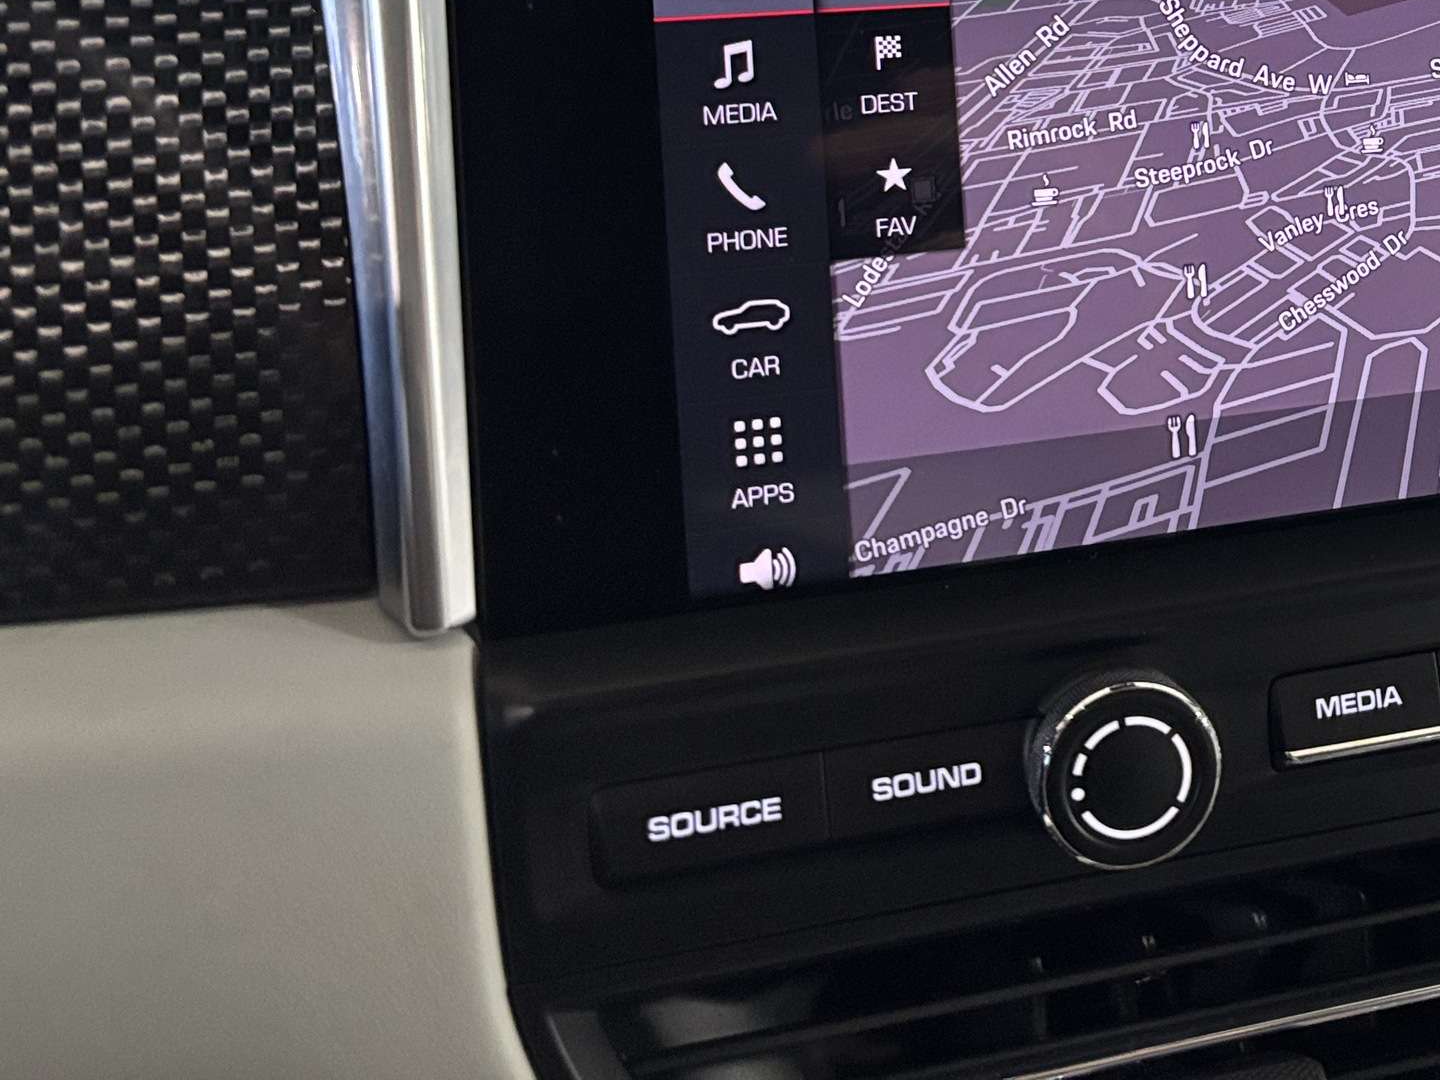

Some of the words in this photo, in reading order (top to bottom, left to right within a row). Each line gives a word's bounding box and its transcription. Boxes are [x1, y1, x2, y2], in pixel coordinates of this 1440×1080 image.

[984, 46, 1037, 98] Allen
[1036, 15, 1071, 52] Rd
[1253, 64, 1296, 92] Ave
[1308, 74, 1332, 95] W
[702, 101, 778, 126] MEDIA
[860, 92, 918, 115] DEST
[1007, 117, 1098, 151] Rimrock
[1108, 109, 1139, 133] Rd
[1134, 149, 1242, 189] Steeprock
[1249, 138, 1275, 159] Dr
[707, 228, 788, 253] PHONE
[875, 215, 917, 238] FAV
[1259, 210, 1325, 253] Vanley
[1334, 200, 1379, 223] Cres
[1278, 251, 1382, 333] Chesswood
[1383, 228, 1410, 255] Dr
[731, 355, 781, 381] CAR
[730, 481, 796, 510] APPS
[854, 510, 989, 563] Champagne
[1000, 497, 1028, 520] Dr
[1315, 683, 1403, 721] MEDIA
[871, 761, 983, 802] SOUND
[646, 796, 783, 843] SOURCE
